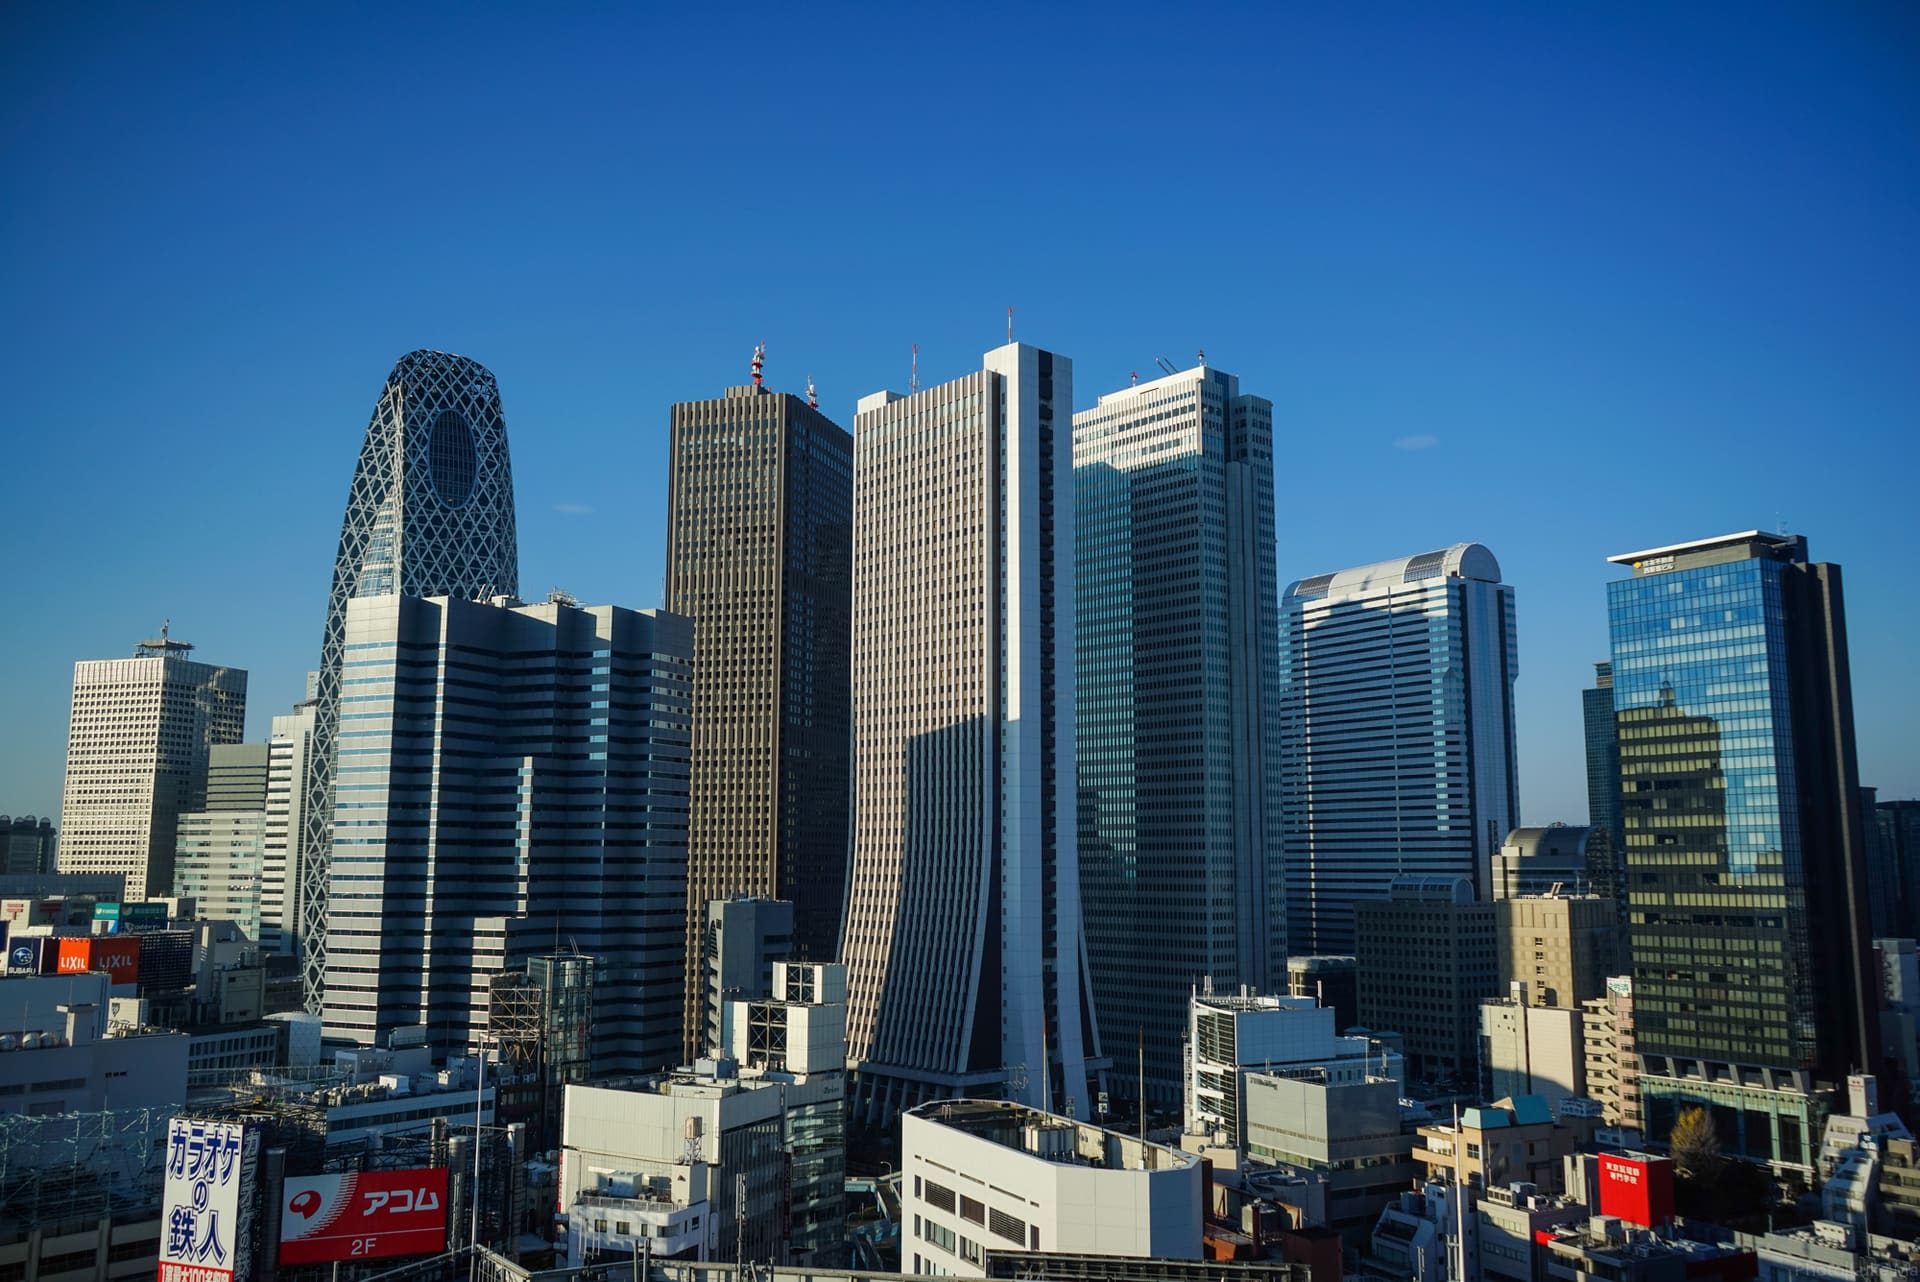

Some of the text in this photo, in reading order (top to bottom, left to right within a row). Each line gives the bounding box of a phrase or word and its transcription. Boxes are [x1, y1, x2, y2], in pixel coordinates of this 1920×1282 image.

[8, 967, 36, 975] SUBARU
[61, 957, 86, 970] LIXIL
[99, 955, 132, 968] LIXIL
[169, 1121, 241, 1186] カラオケ
[192, 1178, 209, 1213] の
[363, 1187, 440, 1217] アコム
[167, 1205, 227, 1266] 鉄人
[351, 1238, 378, 1256] 2F
